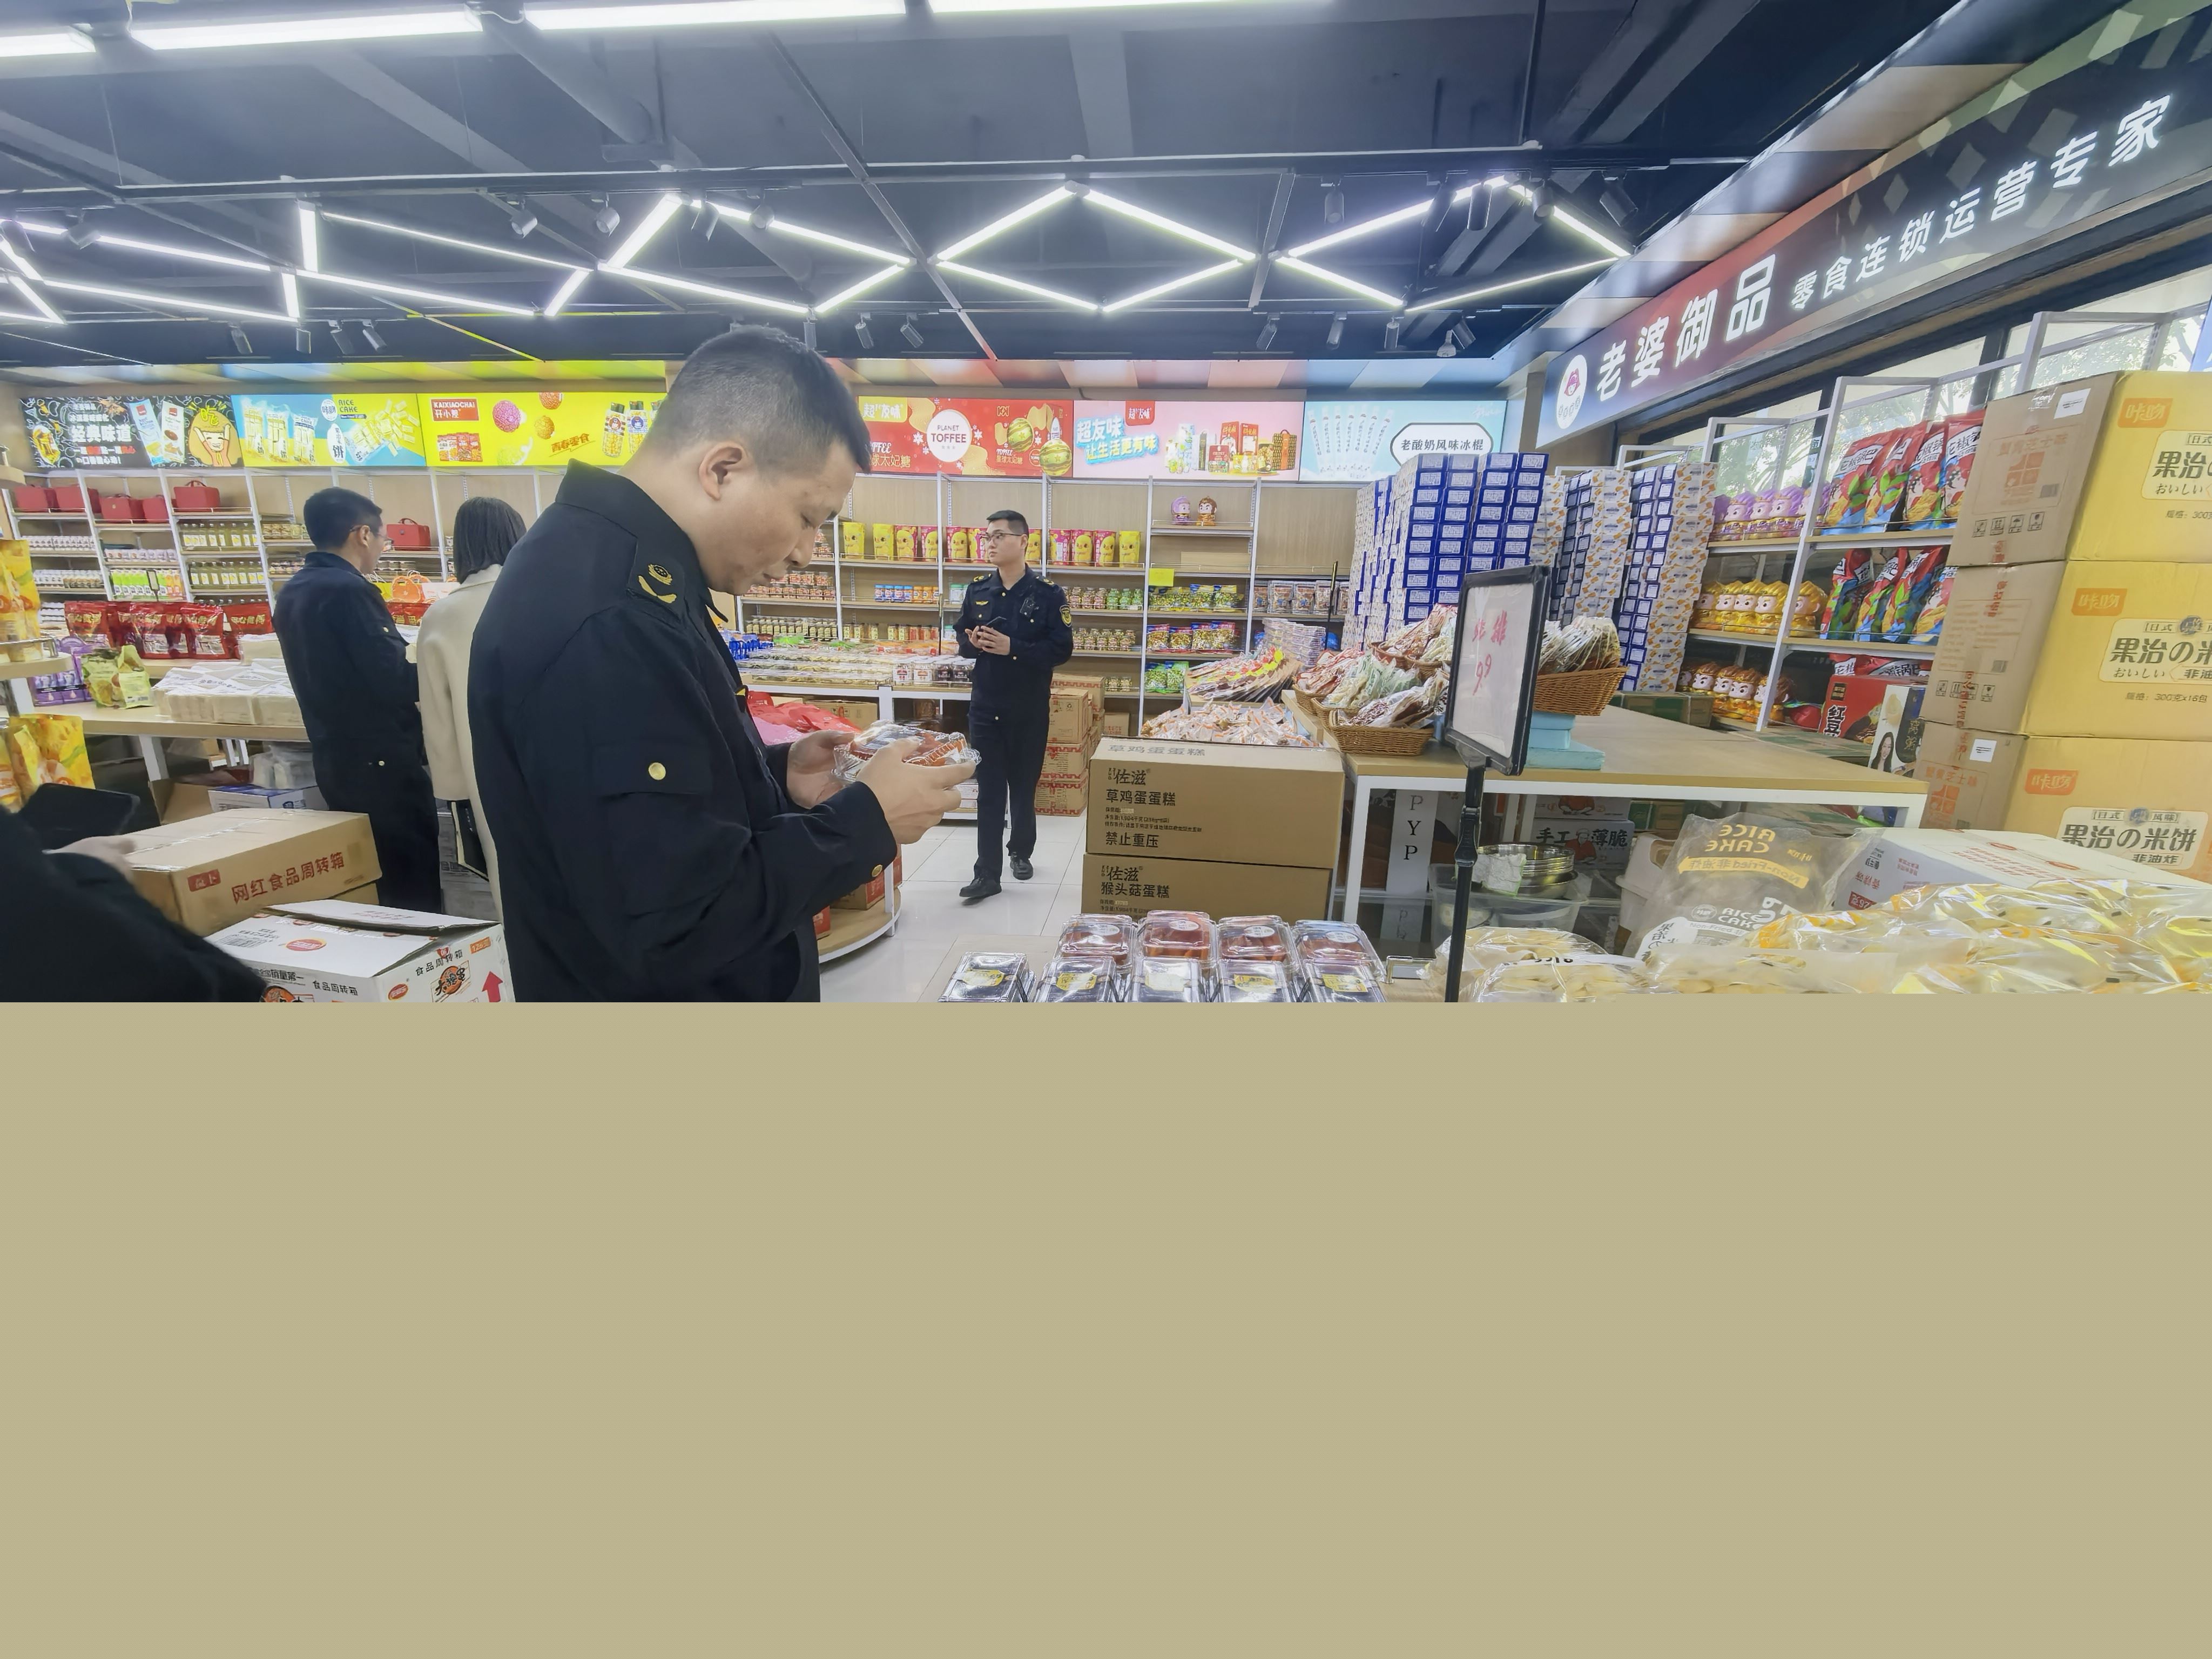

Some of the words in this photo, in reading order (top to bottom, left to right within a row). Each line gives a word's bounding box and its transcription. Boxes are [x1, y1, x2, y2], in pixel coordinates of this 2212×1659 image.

[1790, 95, 2171, 310] 零食连锁运营专家
[1597, 254, 1776, 402] 老婆御品
[931, 433, 967, 443] TOFFEE
[1077, 416, 1122, 444] 超友味
[1086, 434, 1157, 460] 让生活更有味
[1401, 439, 1484, 451] 老酸奶风味冰棍
[871, 454, 911, 468] 球太妃糖
[2152, 450, 2212, 479] 果治
[2156, 483, 2203, 495] おいしい
[2113, 667, 2165, 679] おいしい
[1108, 745, 1205, 756] 草鸡蛋蛋糕
[1114, 768, 1147, 786] 佐滋
[1106, 789, 1176, 806] 草鸡蛋蛋糕
[1105, 831, 1159, 848] 禁止重压
[1536, 827, 1570, 844] 手工
[1592, 828, 1628, 847] 薄脆
[2061, 824, 2197, 852] 果治の米饼
[2132, 853, 2179, 864] 非油炸
[231, 852, 345, 904] 网红食品周转箱
[1107, 866, 1139, 882] 佐滋
[1101, 882, 1170, 899] 猴头菇蛋糕
